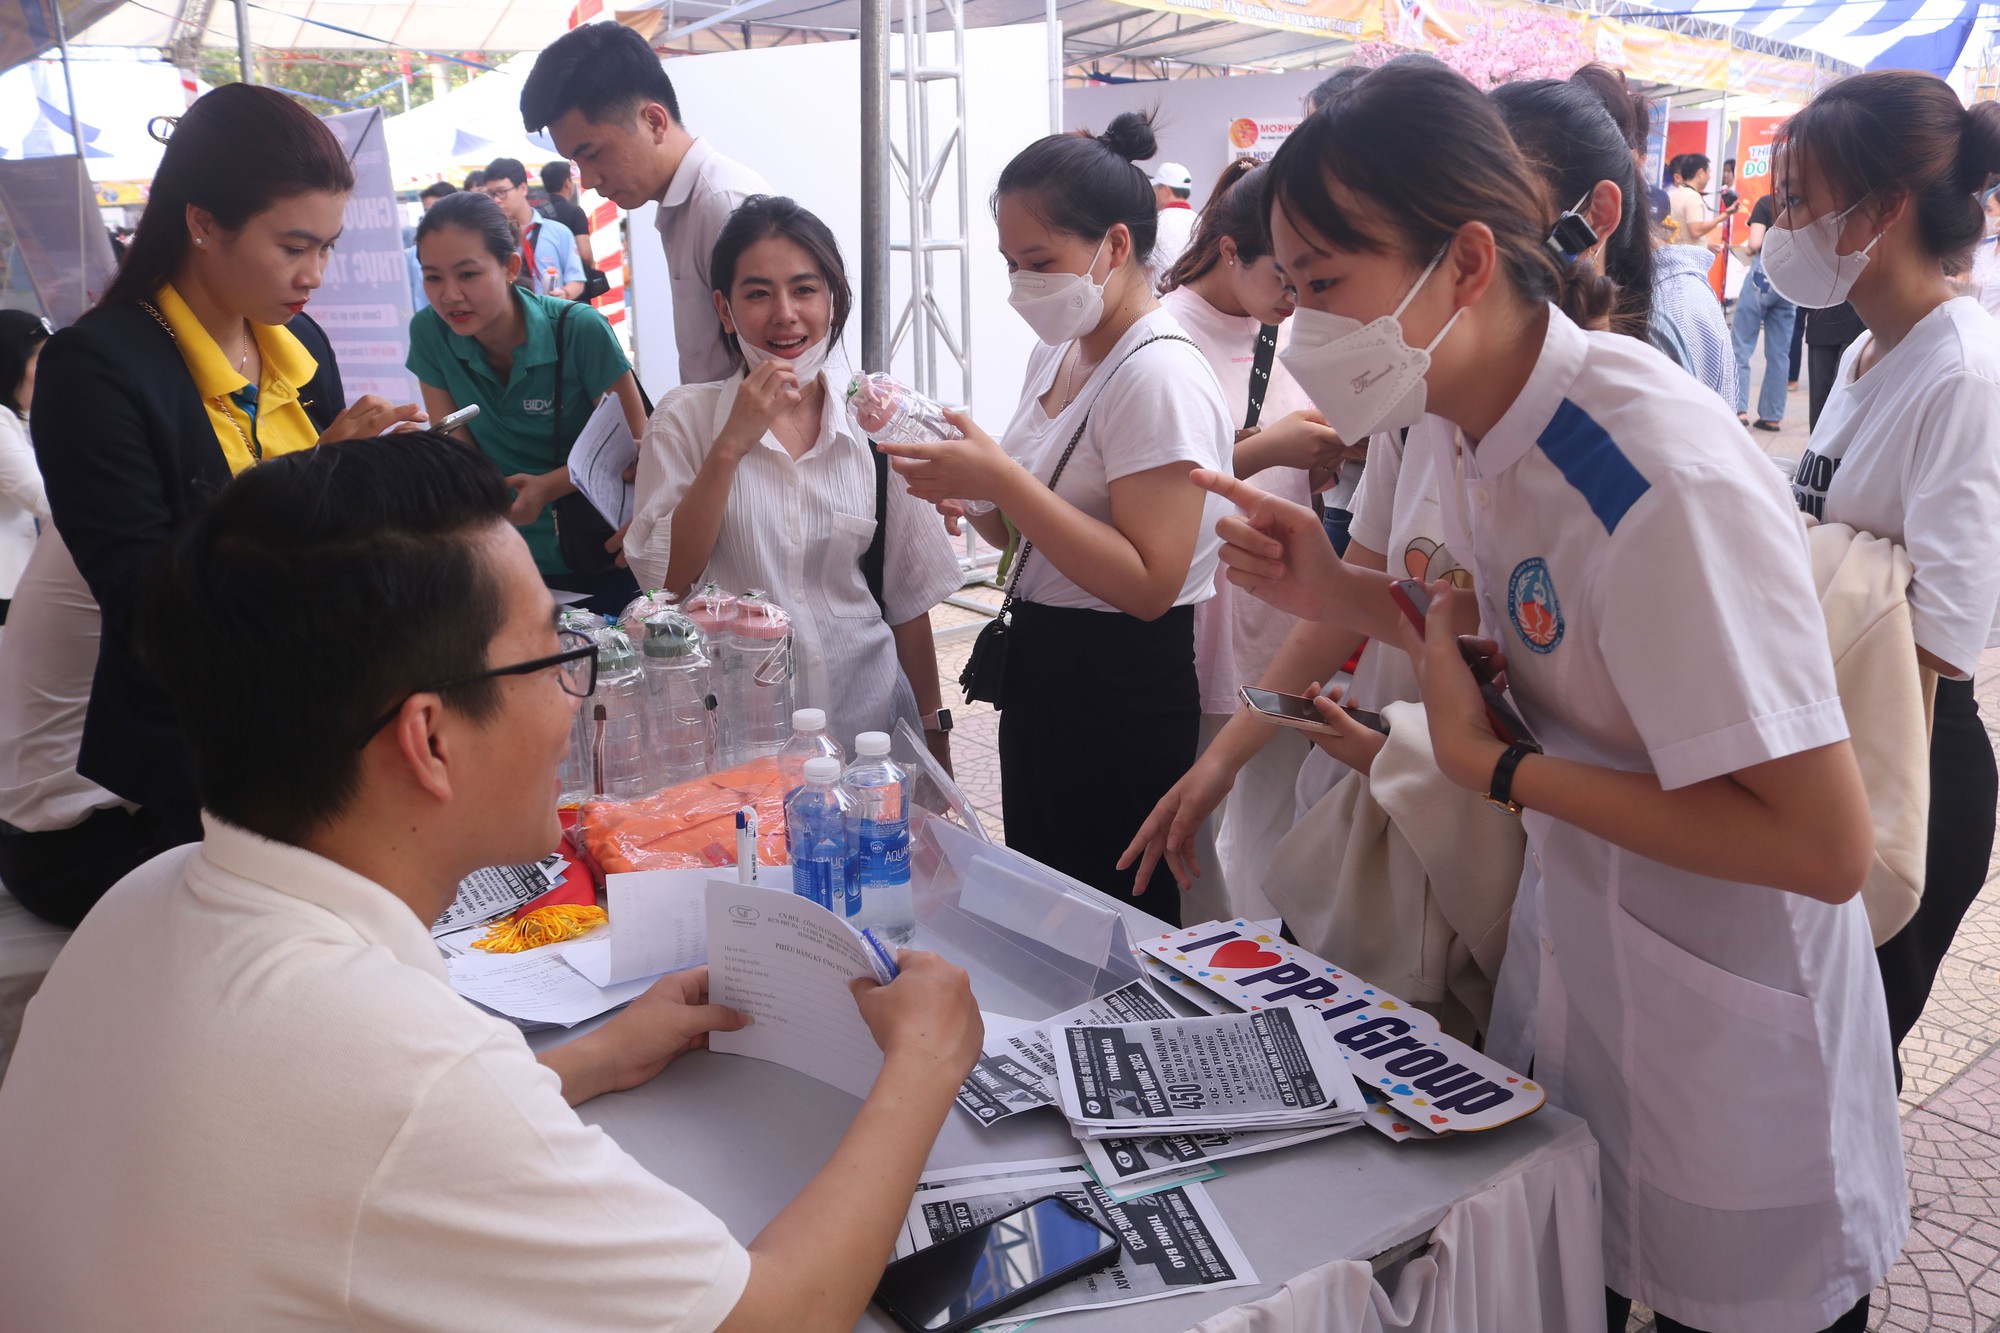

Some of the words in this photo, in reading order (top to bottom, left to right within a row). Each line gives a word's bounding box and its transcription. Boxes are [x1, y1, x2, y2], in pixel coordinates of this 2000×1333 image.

[524, 400, 552, 411] BIDV
[1177, 931, 1243, 953] I
[1333, 1016, 1515, 1115] Group
[1254, 1017, 1268, 1035] NHÂN
[1150, 1027, 1164, 1041] MAY
[1216, 1028, 1232, 1057] CHUYỀN
[1101, 1038, 1114, 1054] BÁO
[1155, 1042, 1170, 1062] NHÂN
[1168, 1039, 1180, 1052] MAY
[1192, 1034, 1205, 1056] HÀNG
[1205, 1036, 1221, 1065] TRƯỞNG
[1261, 1036, 1275, 1053] CÔNG
[1105, 1055, 1121, 1081] THÔNG
[1128, 1053, 1146, 1070] 2023
[1173, 1054, 1184, 1066] TẠO
[1199, 1058, 1213, 1079] KIỂM
[1268, 1054, 1281, 1068] ĐÓN
[1161, 1064, 1176, 1083] CÔNG
[1177, 1068, 1189, 1082] ĐÀO
[1226, 1059, 1241, 1082] THUẬT
[1274, 1068, 1287, 1082] ĐƯA
[1136, 1070, 1155, 1090] DỤNG
[1216, 1068, 1233, 1098] CHUYỀN
[1280, 1083, 1291, 1092] XE
[1144, 1090, 1166, 1113] TUYỂN
[1167, 1084, 1206, 1109] 450
[1209, 1087, 1219, 1099] QC
[1284, 1093, 1295, 1102] CÓ
[955, 1207, 968, 1217] CÓ
[959, 1218, 971, 1228] XE
[1107, 1207, 1133, 1230] DỤNG
[1123, 1230, 1147, 1250] 2023
[1147, 1214, 1173, 1246] THÔNG
[1165, 1248, 1186, 1268] BÁO
[1110, 1270, 1131, 1289] MAY
